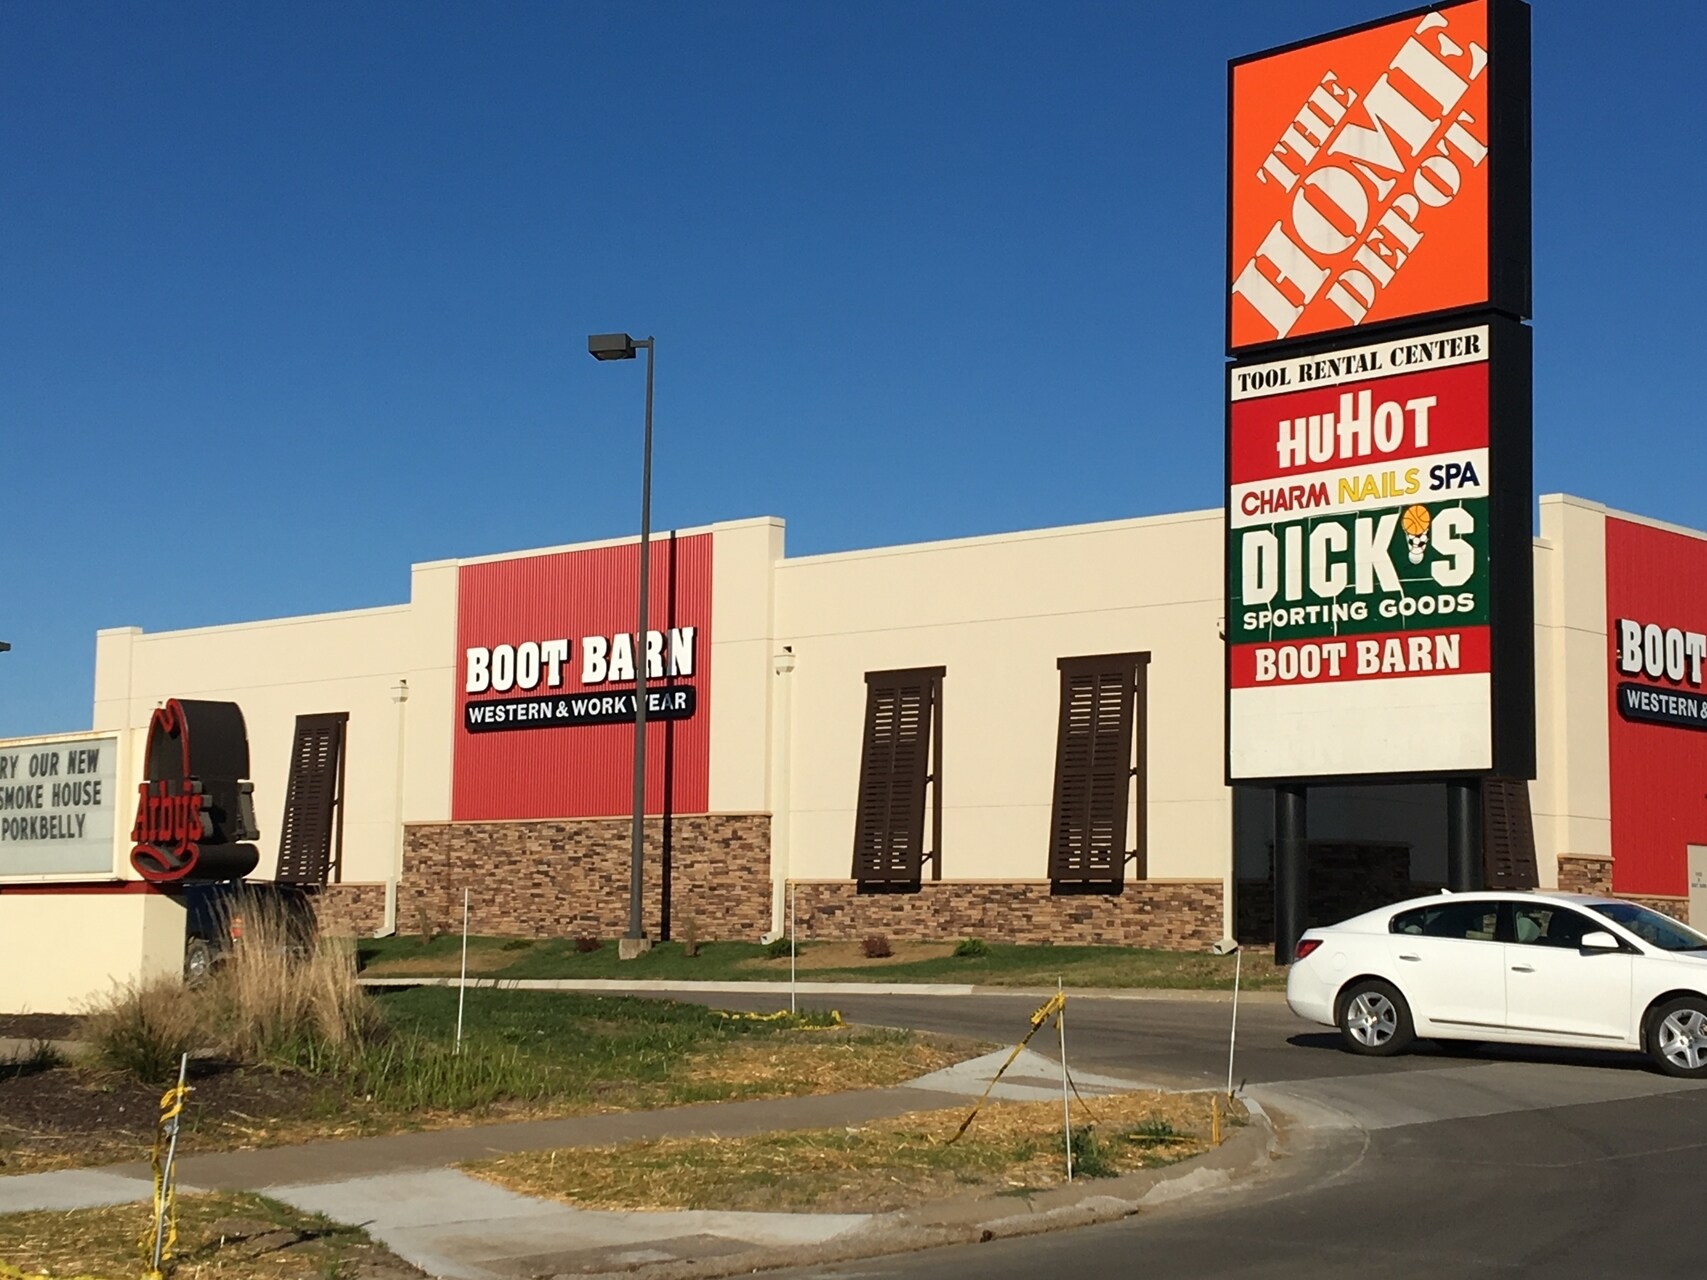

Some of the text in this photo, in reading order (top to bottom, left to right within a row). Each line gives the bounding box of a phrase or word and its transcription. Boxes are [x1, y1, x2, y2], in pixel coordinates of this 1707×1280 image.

[1256, 69, 1359, 193] THE
[1232, 10, 1488, 340] HOME
[1325, 109, 1488, 326] DEPOT
[1238, 334, 1481, 392] TOOL RENTAL CENTER
[1241, 461, 1480, 516] CHARM NAILS SPA
[1243, 592, 1475, 630] SPORTING GOODS
[466, 626, 695, 693] BOOT BARN
[1255, 634, 1460, 682] BOOT BARN
[1621, 618, 1707, 684] BOOT
[468, 702, 552, 724] WESTERN
[556, 703, 569, 718] &
[571, 696, 627, 717] WORK
[1627, 689, 1697, 718] WESTERN
[29, 752, 59, 778] OUR
[67, 749, 100, 775] NEW
[0, 780, 102, 810] SMOKE HOUSE
[2, 814, 86, 841] PORKBELLY
